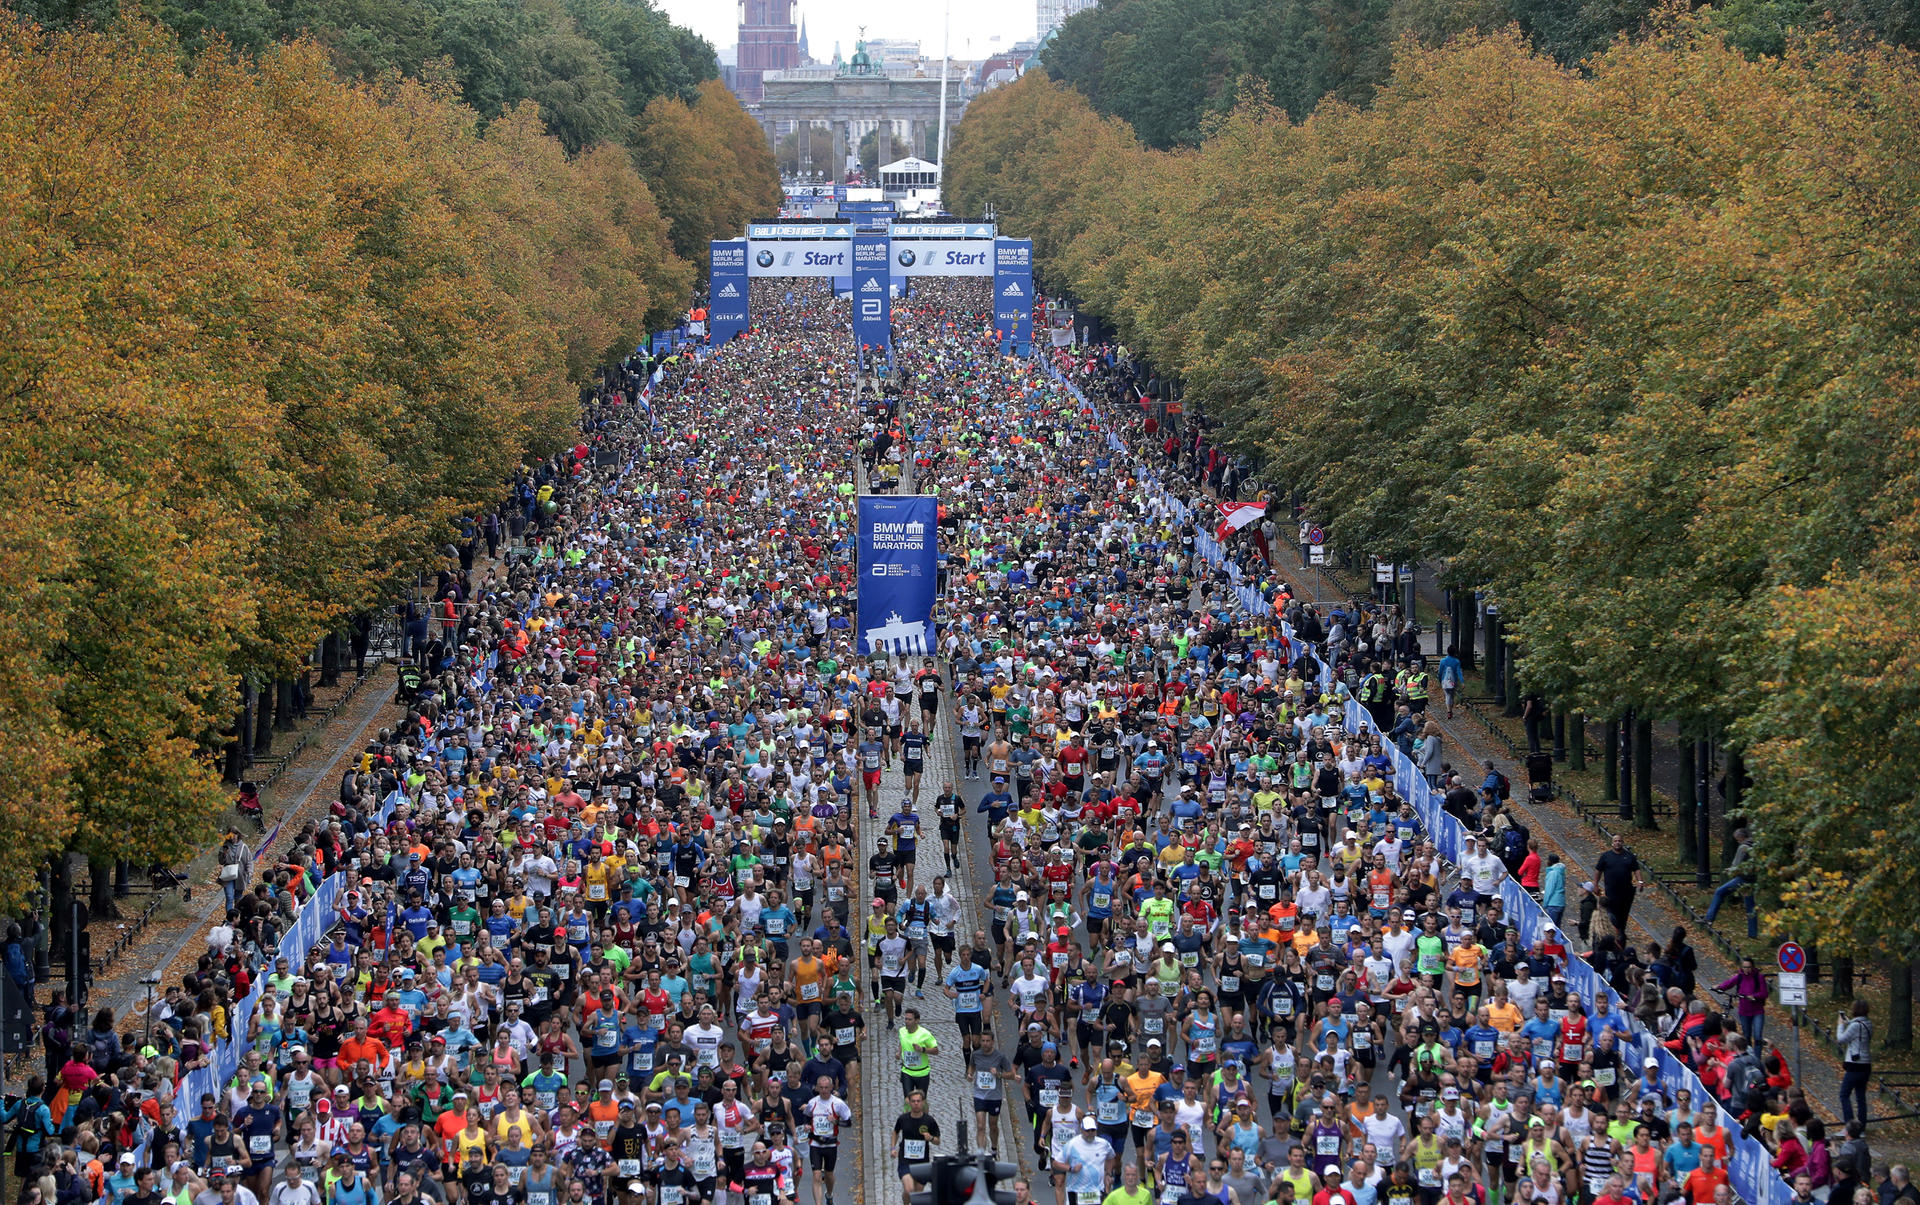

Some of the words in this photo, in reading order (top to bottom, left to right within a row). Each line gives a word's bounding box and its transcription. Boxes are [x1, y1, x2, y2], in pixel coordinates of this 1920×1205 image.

[804, 252, 844, 265] Start
[945, 251, 986, 265] Start
[874, 522, 904, 533] BMW
